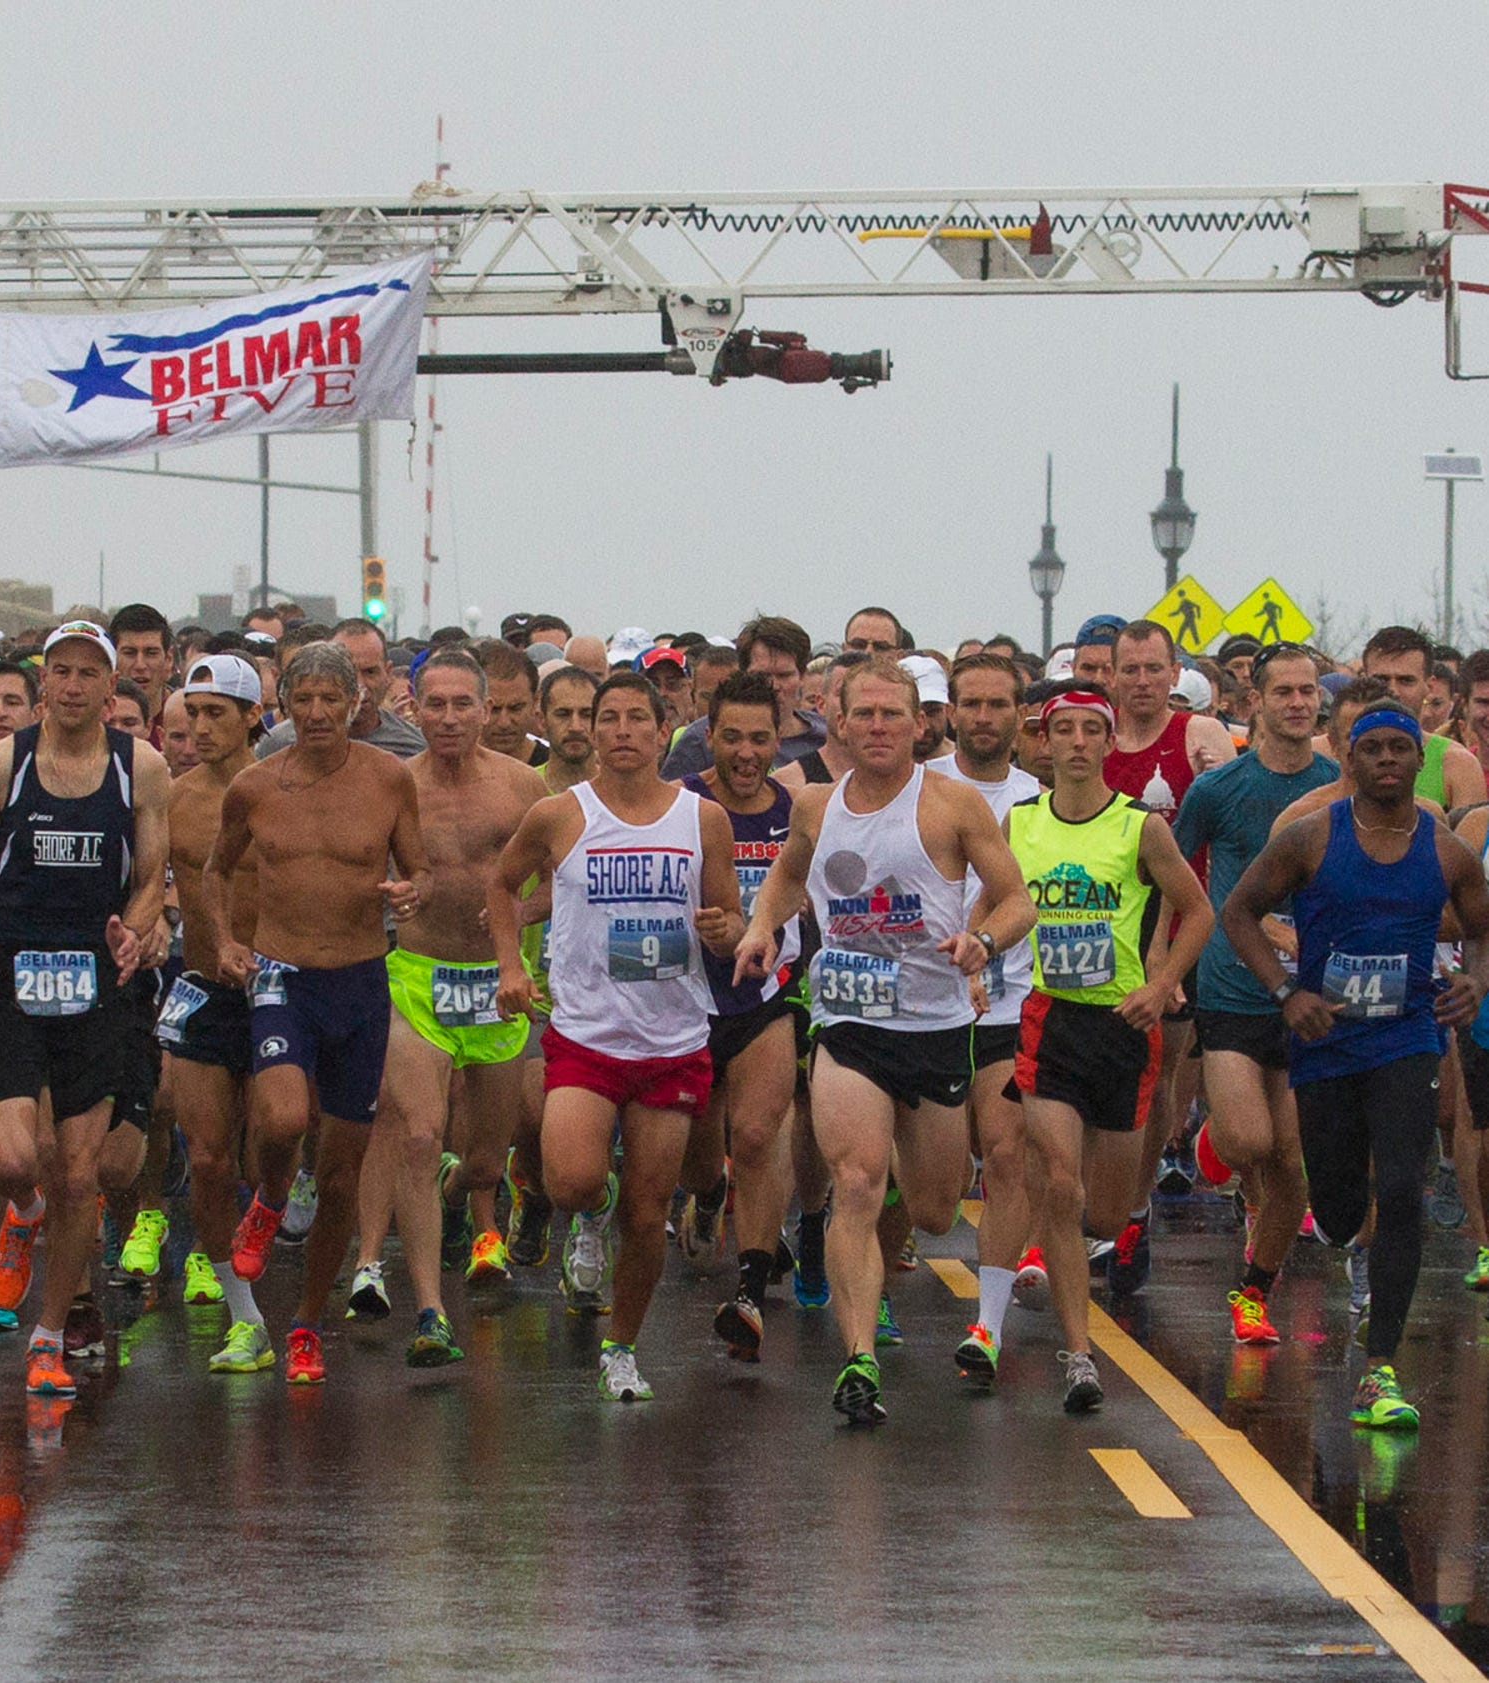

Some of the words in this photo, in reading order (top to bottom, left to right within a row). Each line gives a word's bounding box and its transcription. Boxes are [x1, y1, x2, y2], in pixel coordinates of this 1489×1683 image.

[149, 313, 362, 407] BELMAR
[150, 368, 357, 436] FIVE
[33, 835, 76, 861] SHORE
[587, 854, 653, 896] SHORE
[658, 854, 689, 898] A.C.
[827, 885, 922, 916] IRONMAN
[1027, 879, 1123, 909] OCEAN
[615, 917, 684, 933] BELMAR
[1040, 922, 1108, 940] BELMAR
[21, 953, 90, 967] BELMAR
[642, 935, 660, 967] 9
[825, 951, 894, 972] BELMAR
[1039, 938, 1111, 975] 2127
[1333, 954, 1402, 971] BELMAR
[17, 969, 94, 1002] 2064
[438, 966, 499, 980] BELMA
[822, 968, 895, 1004] 3335
[1343, 974, 1383, 1004] 44
